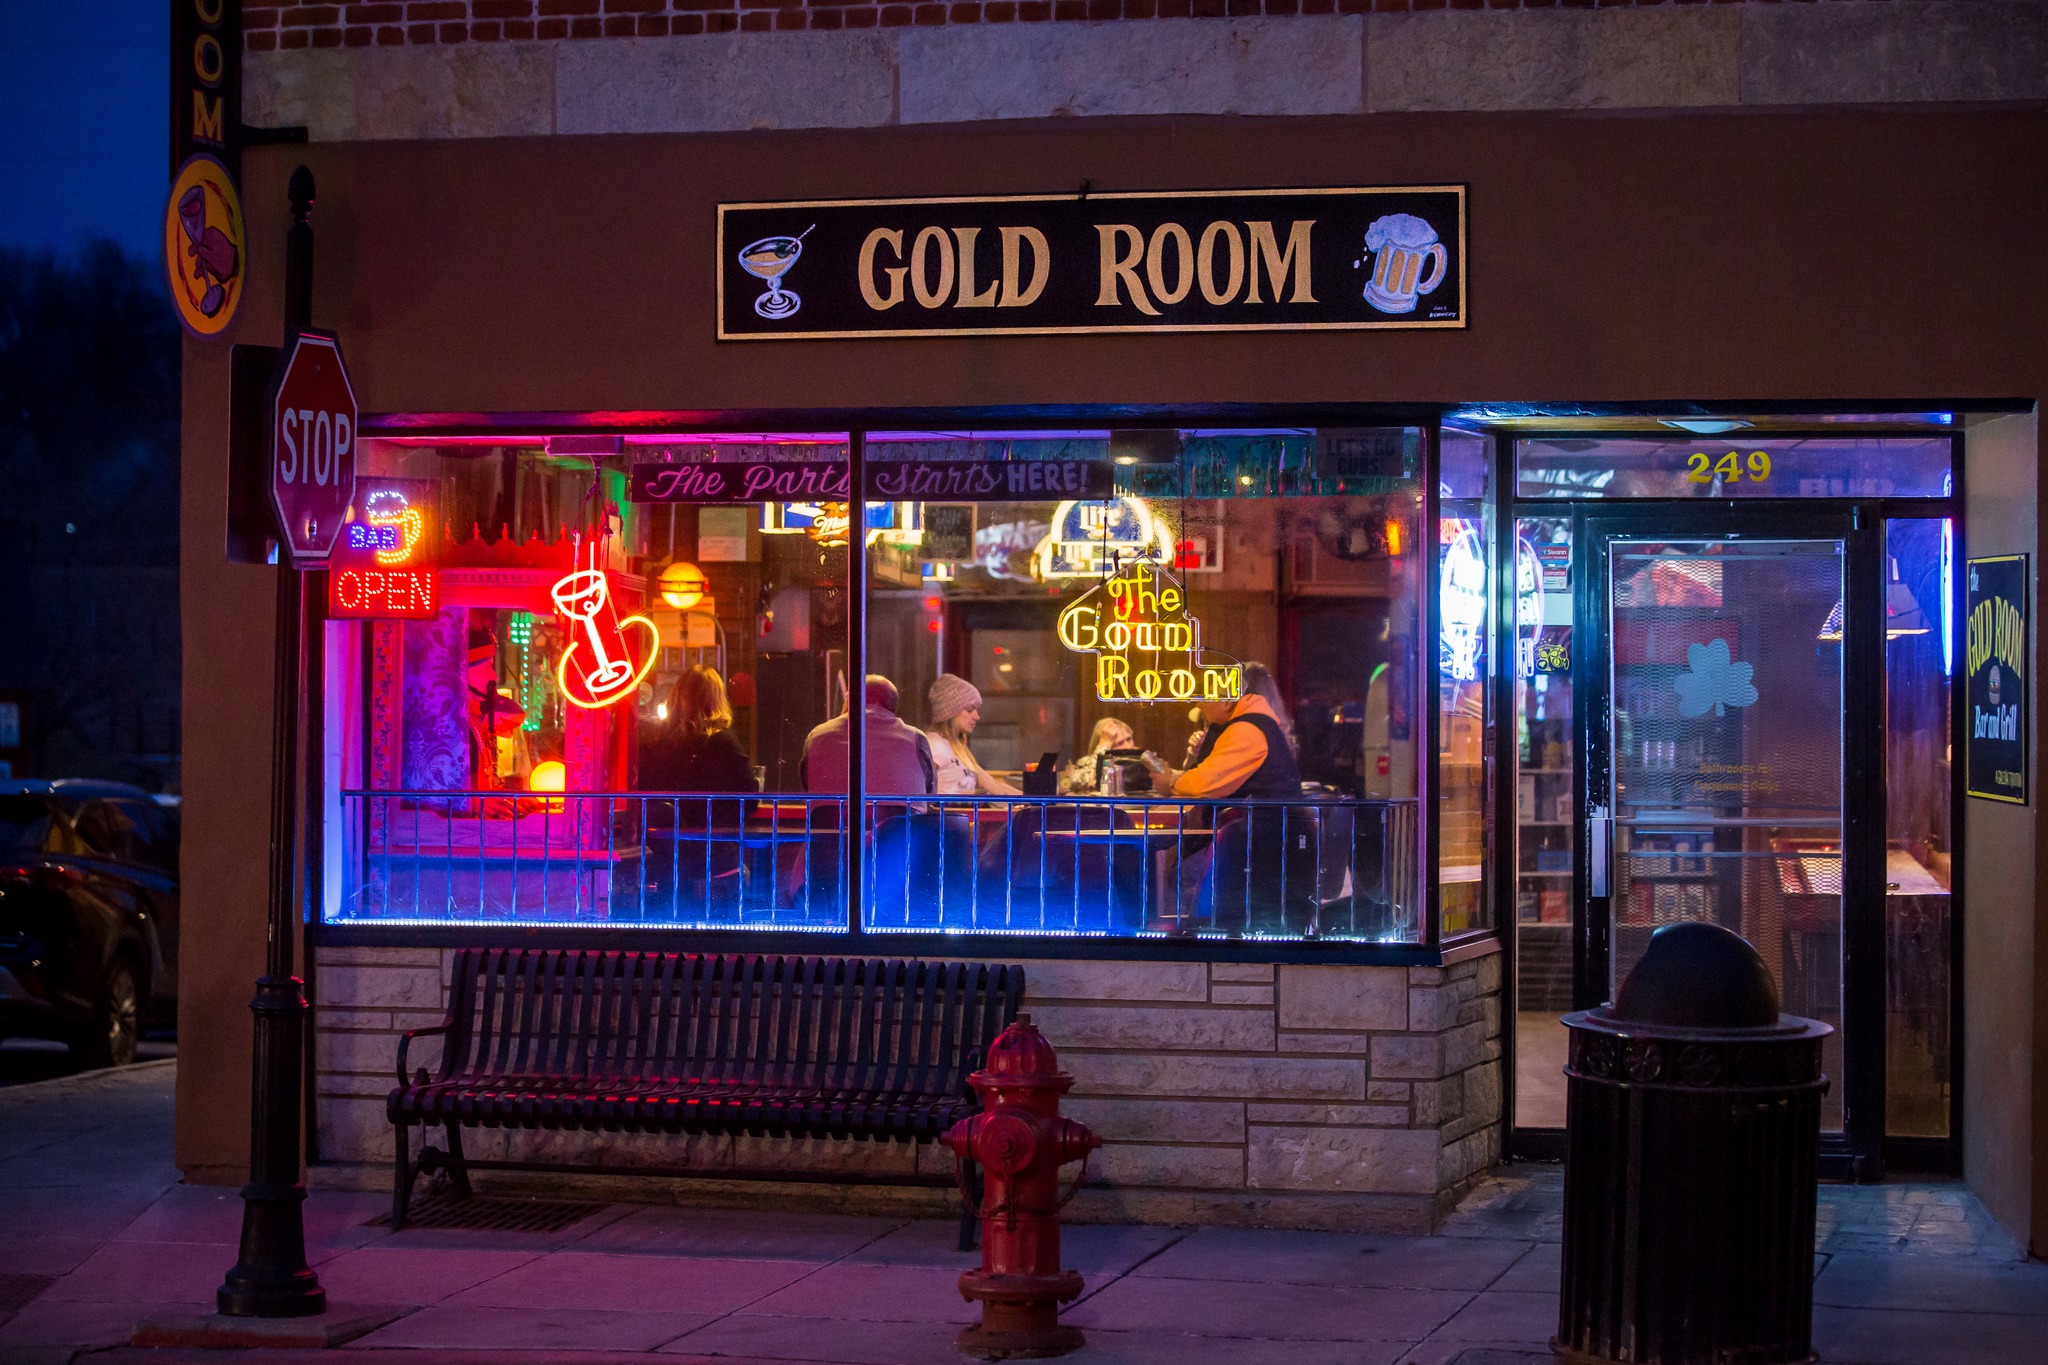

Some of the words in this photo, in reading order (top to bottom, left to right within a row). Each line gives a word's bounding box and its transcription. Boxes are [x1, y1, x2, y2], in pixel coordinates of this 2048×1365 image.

[857, 225, 1051, 311] GOLD
[1093, 220, 1320, 316] ROOM
[281, 408, 351, 487] STOP
[1687, 451, 1771, 483] 249
[645, 465, 726, 498] The
[875, 463, 1002, 495] Starts
[1007, 462, 1088, 494] HERE!
[351, 525, 396, 550] BAR
[337, 569, 432, 611] OPEN
[1107, 564, 1181, 620] The
[1970, 566, 1979, 592] the
[1967, 599, 1993, 678] GOLD
[1994, 595, 2024, 679] ROOM
[1974, 704, 1988, 740] Bar
[1988, 706, 2001, 740] and
[2001, 703, 2018, 741] Grill
